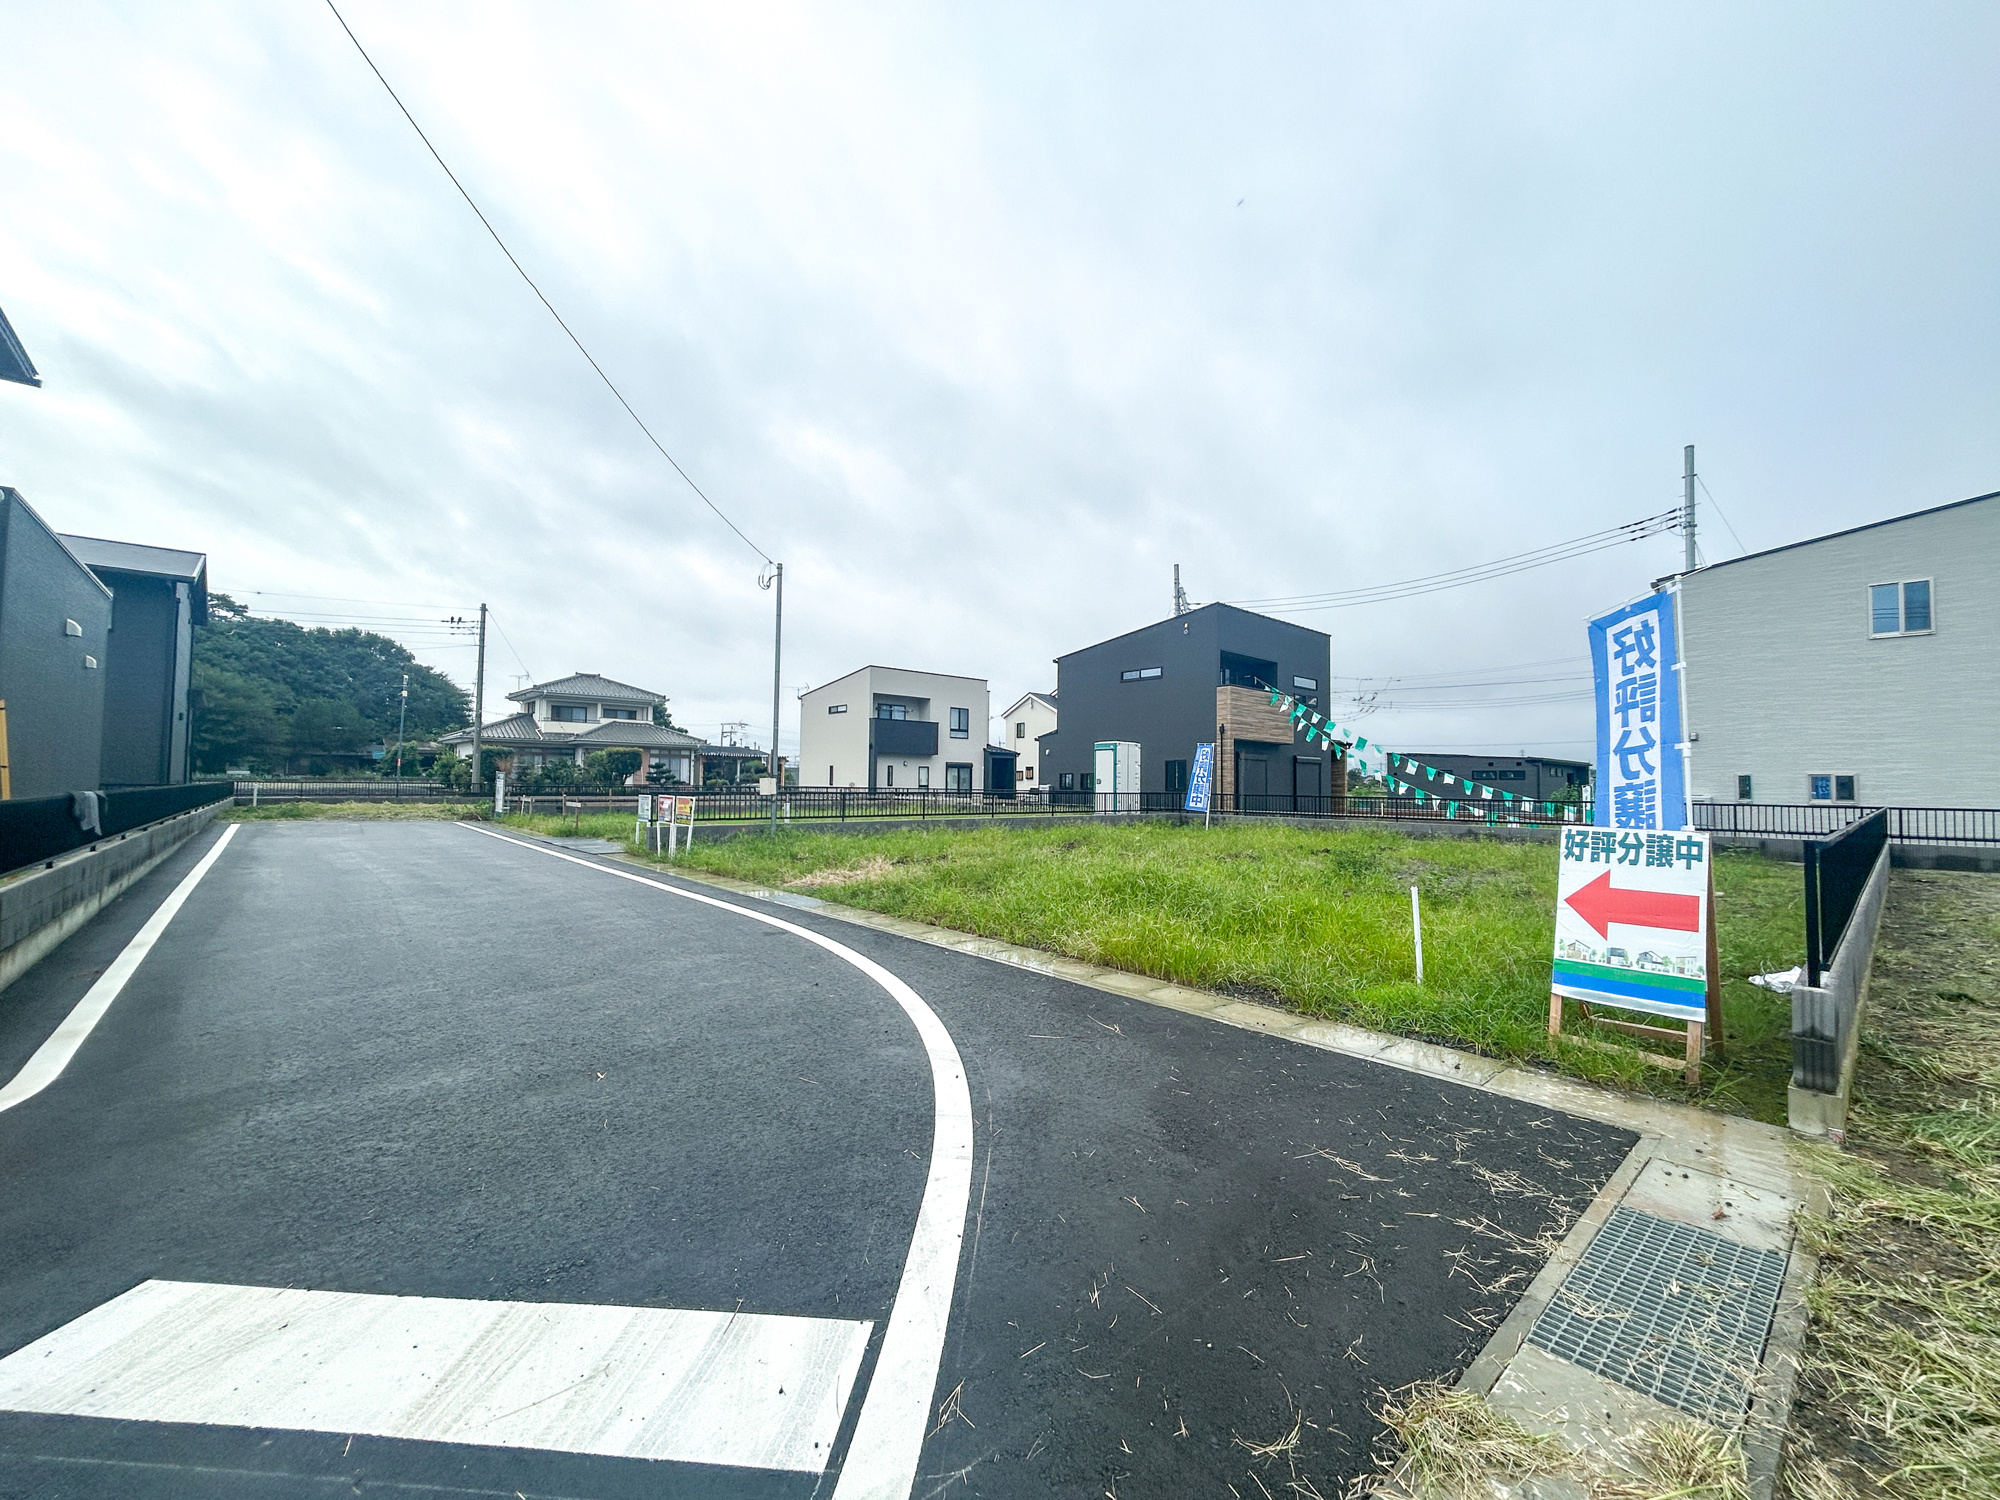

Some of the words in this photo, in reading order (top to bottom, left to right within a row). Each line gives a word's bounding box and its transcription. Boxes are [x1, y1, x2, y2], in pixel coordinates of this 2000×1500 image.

[1564, 829, 1703, 870] 好評分譲中
